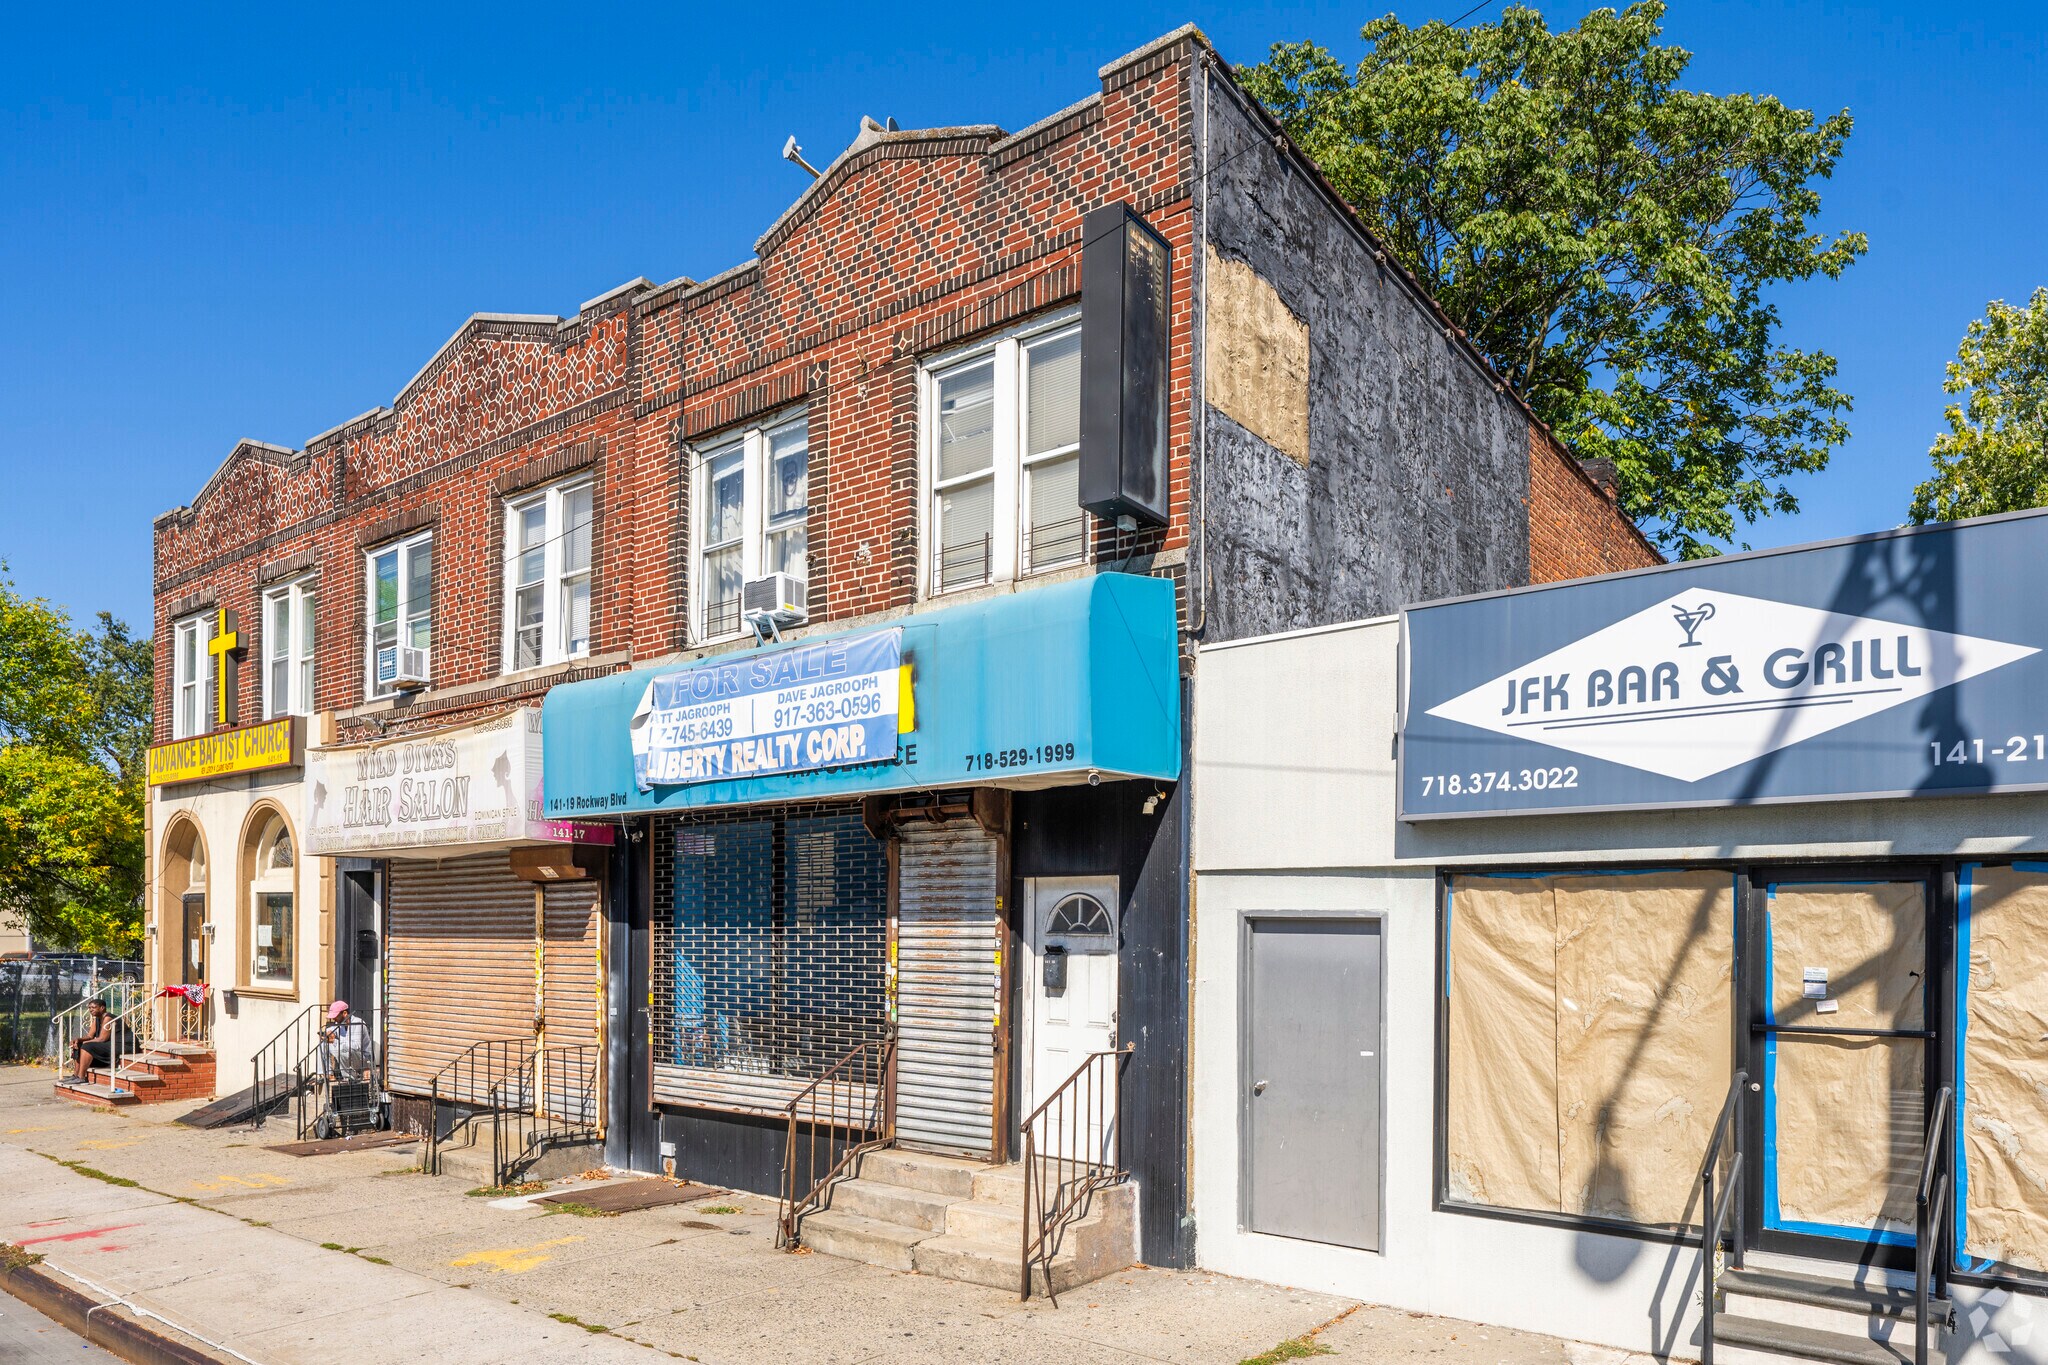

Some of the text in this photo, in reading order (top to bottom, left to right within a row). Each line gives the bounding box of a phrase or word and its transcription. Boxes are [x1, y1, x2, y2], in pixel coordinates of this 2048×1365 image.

[1155, 247, 1163, 323] SERVICE
[671, 641, 848, 705] FOR SALE
[1502, 635, 1922, 716] JFK BAR & GRILL
[778, 676, 878, 705] DAVE JAGROOPH
[676, 702, 731, 721] JAGROOPH
[774, 693, 881, 729] 917-363-0596
[153, 740, 196, 774] ADVANCE
[199, 731, 240, 767] BAPTIST
[243, 720, 290, 759] CHURCH
[646, 744, 727, 779] LIBERTY
[732, 732, 803, 773] REALTY
[807, 724, 866, 763] CORP.
[966, 743, 1075, 772] 718-529-1999
[1930, 734, 2044, 766] 141-21
[356, 749, 397, 781] WILD
[1422, 766, 1578, 796] 718.374.3022
[343, 776, 471, 828] HAIR SALON
[550, 797, 575, 811] 141-19
[576, 795, 609, 810] Rockway
[610, 792, 627, 806] Blvd
[553, 827, 585, 839] 141-17
